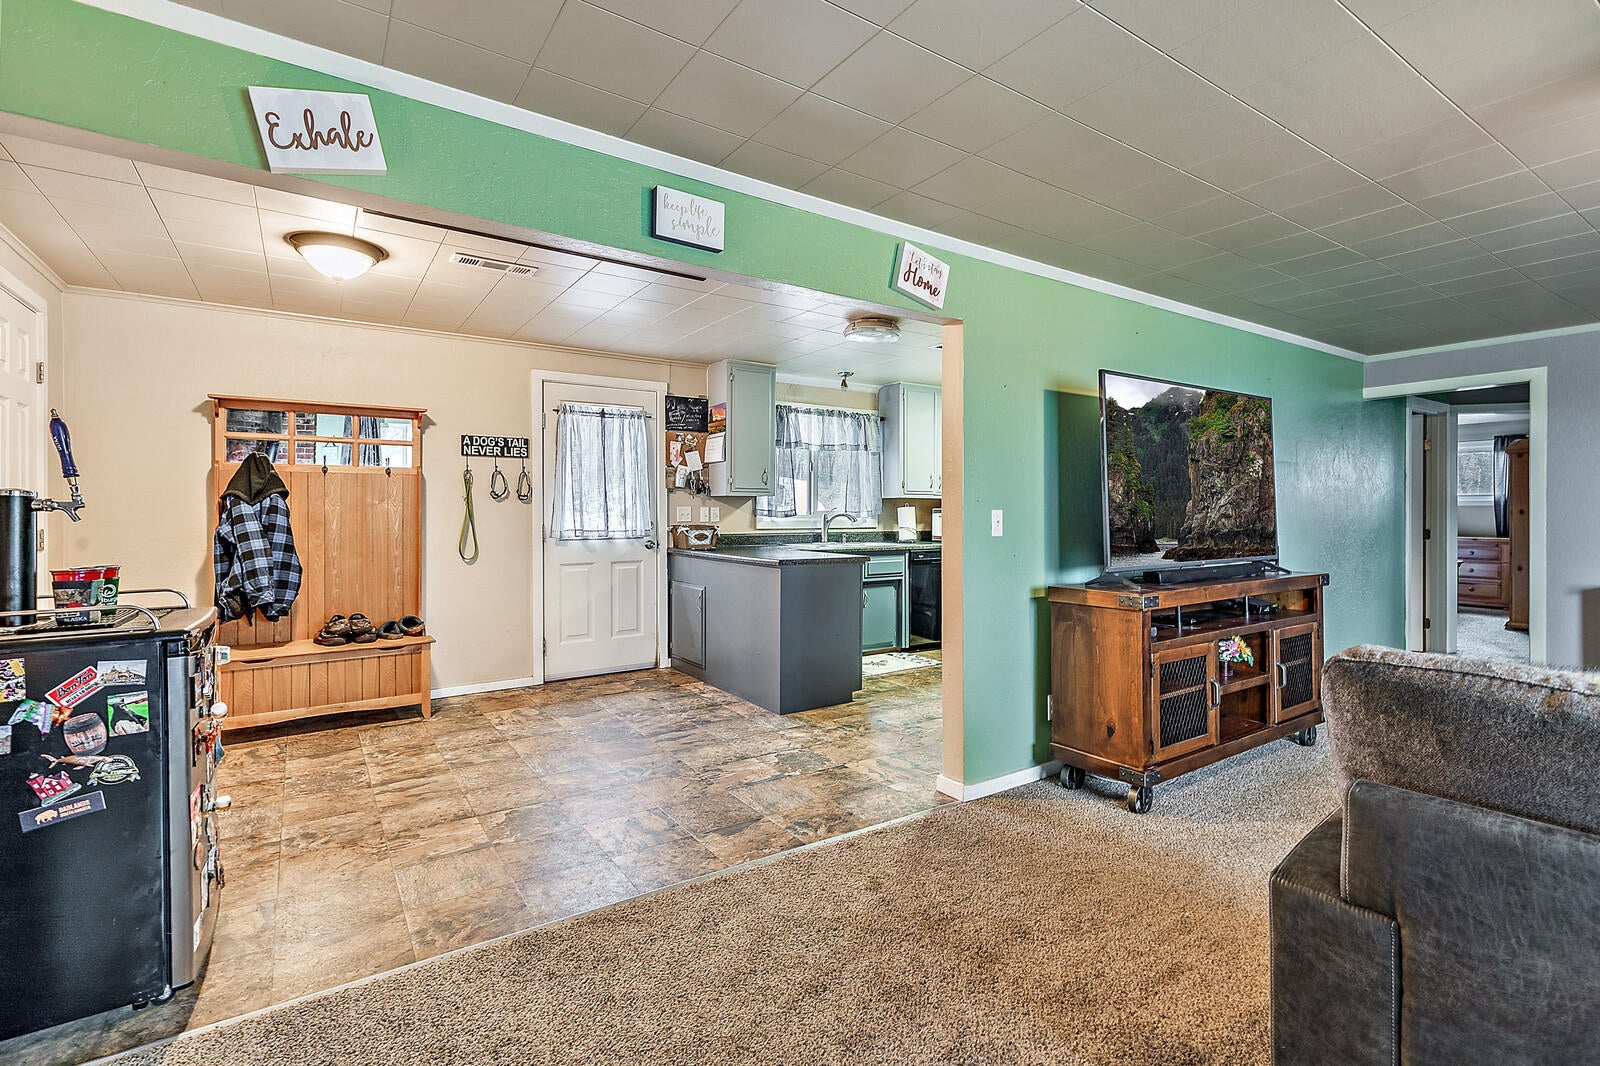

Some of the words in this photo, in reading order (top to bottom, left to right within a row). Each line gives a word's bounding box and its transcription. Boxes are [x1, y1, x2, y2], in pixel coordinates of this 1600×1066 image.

[265, 108, 374, 152] Exhale
[663, 192, 687, 216] keep
[689, 199, 707, 219] life
[671, 215, 720, 240] simple
[910, 251, 928, 269] Let's
[927, 263, 943, 279] stay
[903, 262, 940, 297] Home
[463, 436, 471, 445] A
[472, 436, 504, 447] DOG'S
[506, 438, 528, 448] TAIL
[463, 445, 501, 456] NEVER
[504, 447, 528, 457] LIES
